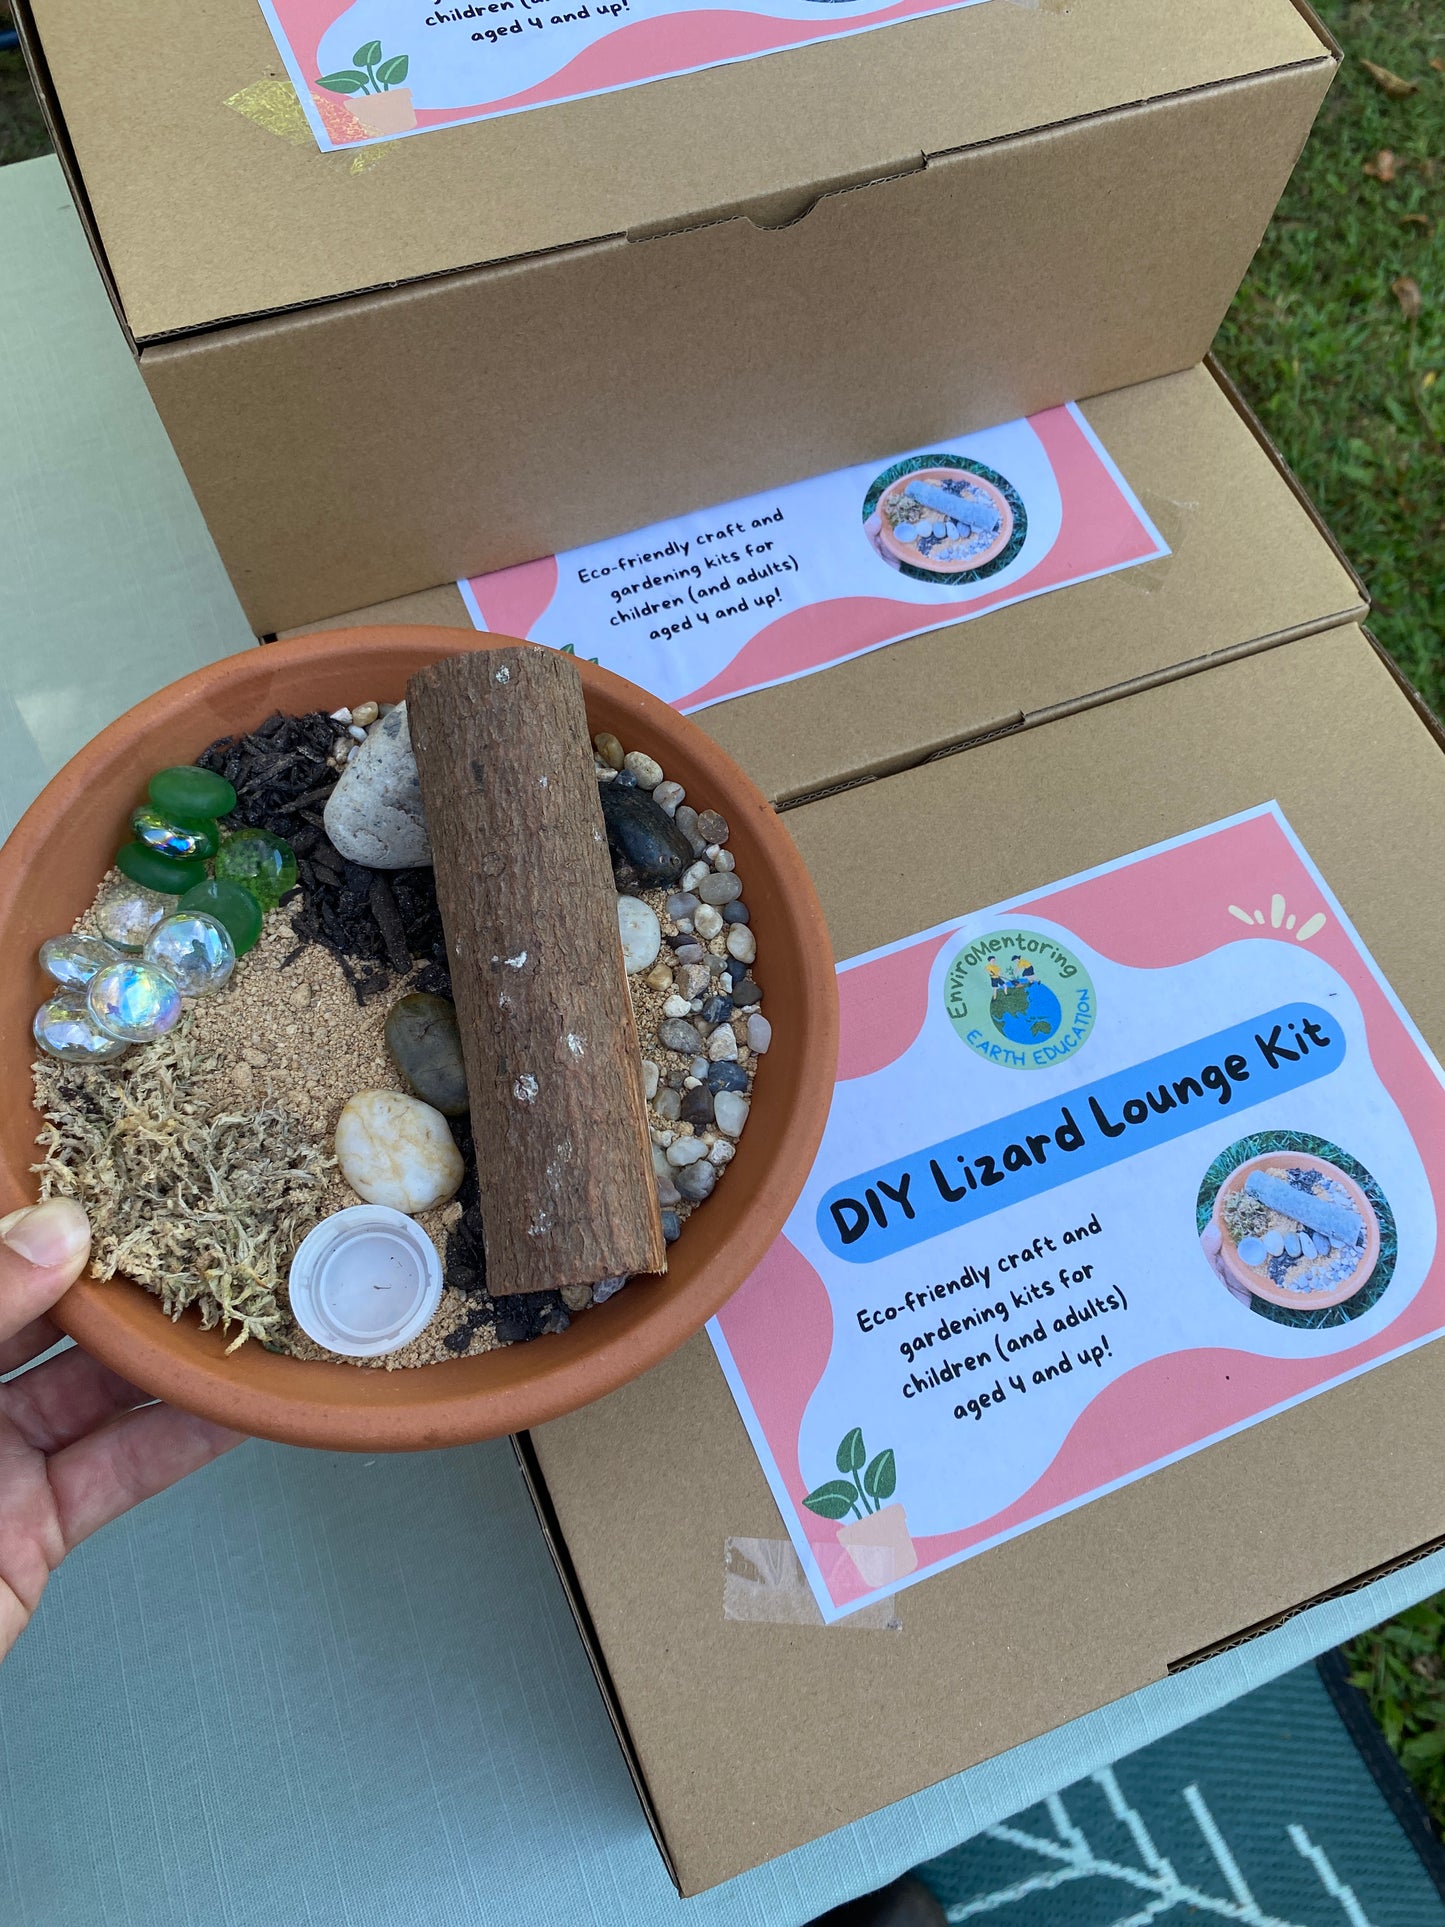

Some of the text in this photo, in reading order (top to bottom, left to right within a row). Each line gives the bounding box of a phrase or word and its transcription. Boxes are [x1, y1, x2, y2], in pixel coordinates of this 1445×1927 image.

[425, 1, 514, 26] children
[471, 0, 630, 43] aged 4 and up!
[578, 507, 785, 584] Eco-friendly craft and
[610, 540, 774, 603] gardening kits for
[609, 554, 799, 626] children (and adults)
[649, 586, 783, 640] aged 4 and up!
[946, 933, 1078, 1020] EnviroMentoring
[966, 988, 1092, 1066] EARTH EDUCATION
[829, 1017, 1332, 1245] DIY Lizard Lounge Kit
[856, 1213, 1102, 1333] Eco-friendly craft and
[900, 1264, 1094, 1362] gardening kits for
[902, 1284, 1128, 1398] children (and adults)
[953, 1334, 1113, 1421] aged 4 and up!
